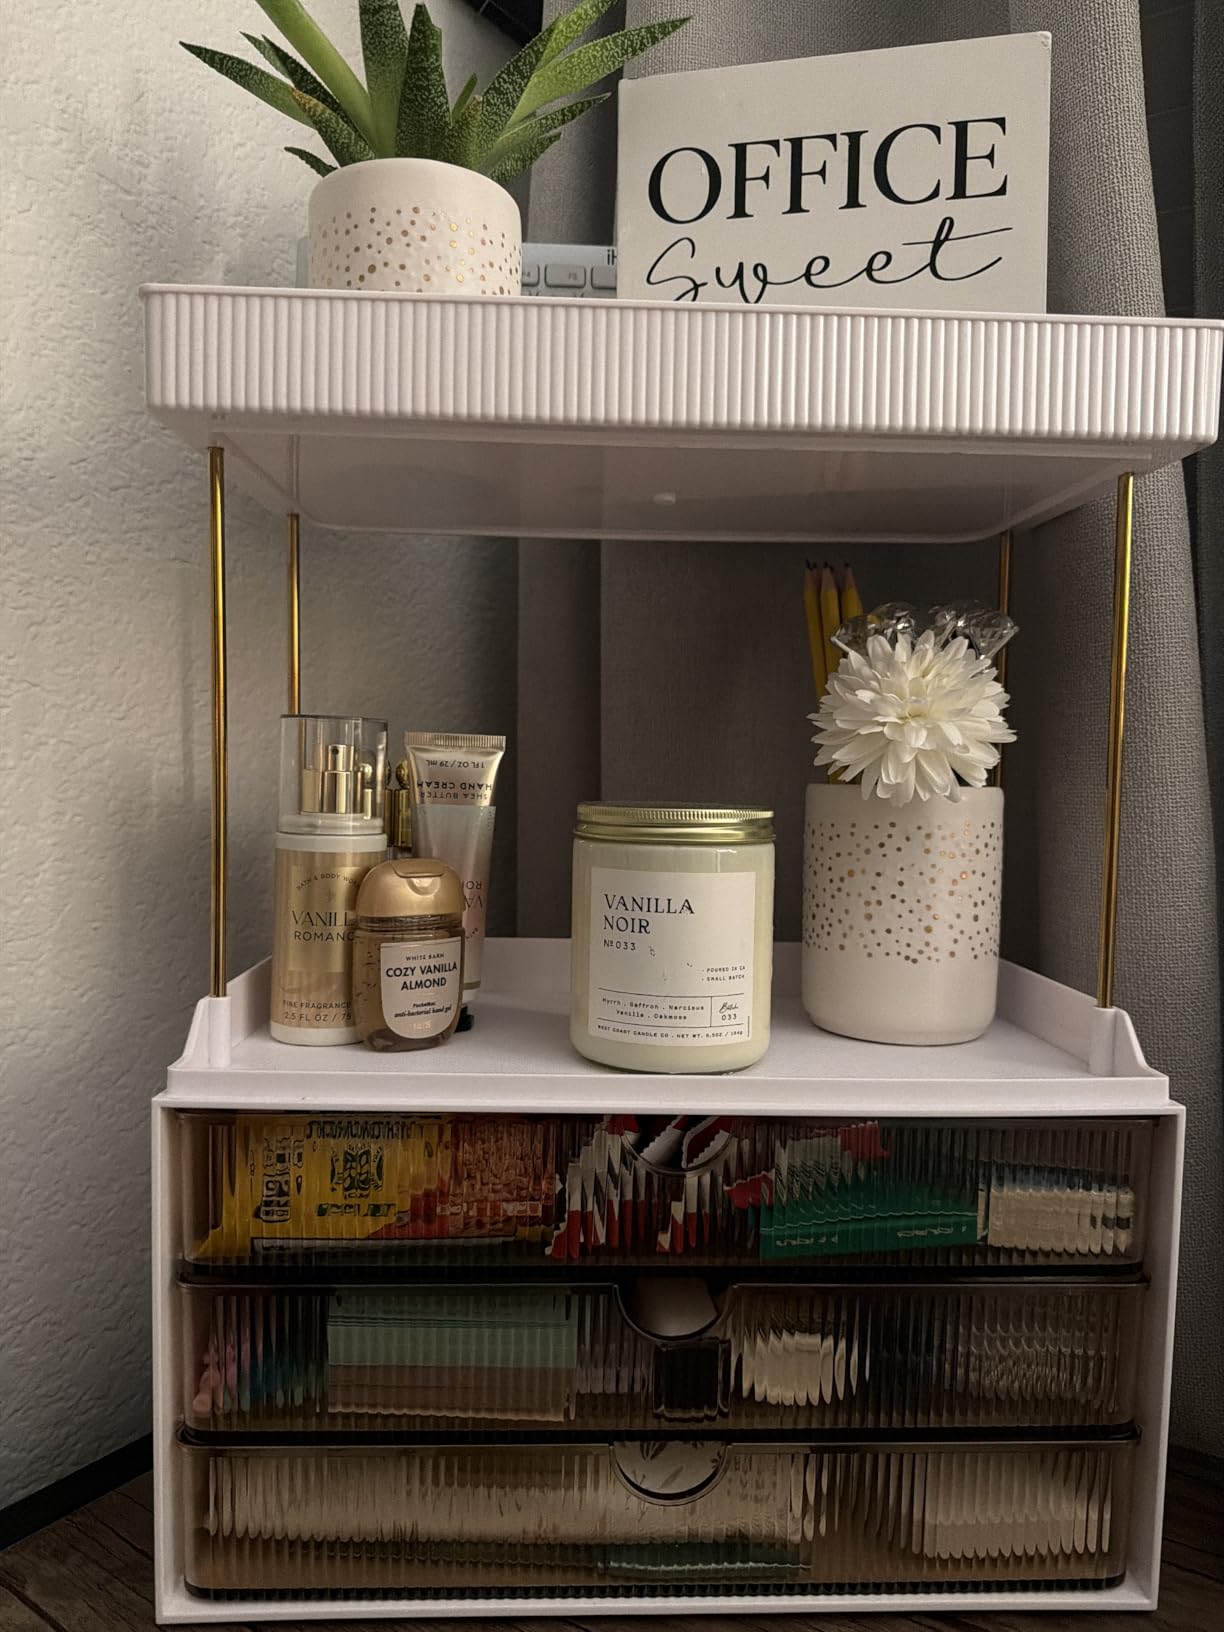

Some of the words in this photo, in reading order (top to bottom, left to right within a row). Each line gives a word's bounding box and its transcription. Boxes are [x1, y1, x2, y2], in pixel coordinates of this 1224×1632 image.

[647, 116, 1008, 225] OFFICE
[646, 216, 1013, 304] Sweet
[460, 782, 493, 791] HAND
[463, 792, 488, 800] SHEA
[604, 893, 695, 915] VANILLA
[292, 910, 355, 927] VANILL
[603, 914, 651, 934] NOIR
[294, 930, 356, 942] ROMANC
[405, 954, 426, 962] WHITE
[386, 966, 417, 978] COZY
[419, 961, 458, 975] VANILLA
[400, 977, 447, 991] ALMOND
[283, 1000, 298, 1008] FINE
[299, 1013, 310, 1022] FL
[315, 1014, 328, 1022] OZ
[721, 1013, 737, 1021] 033
[612, 1027, 631, 1035] COAST
